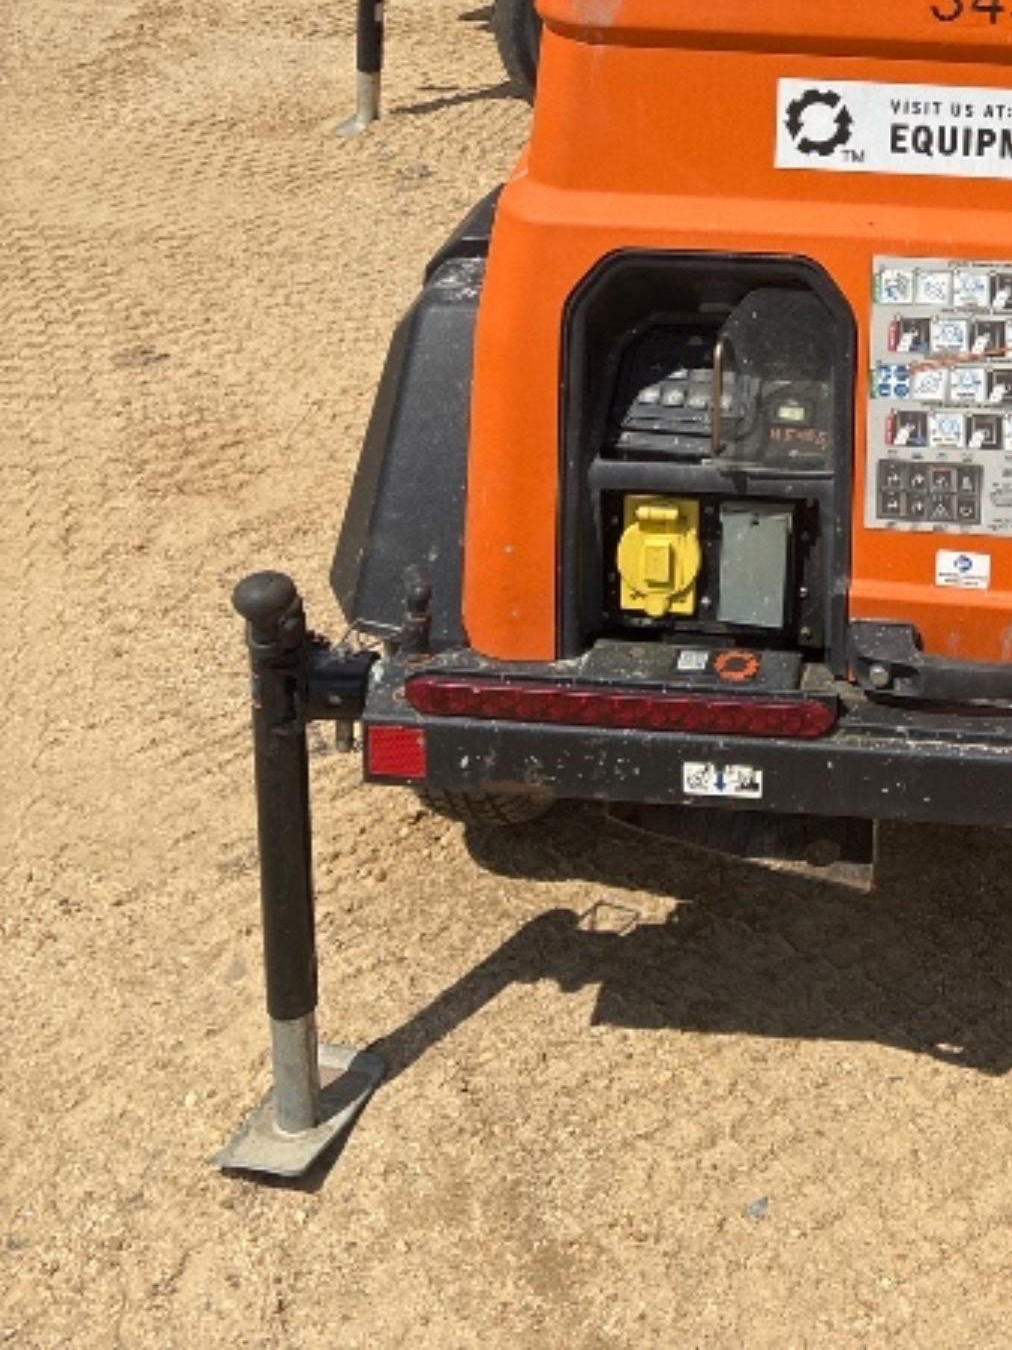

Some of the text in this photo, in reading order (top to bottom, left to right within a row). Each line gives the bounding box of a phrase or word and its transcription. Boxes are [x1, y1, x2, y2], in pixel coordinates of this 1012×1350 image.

[890, 99, 1012, 120] VISIT US AT:
